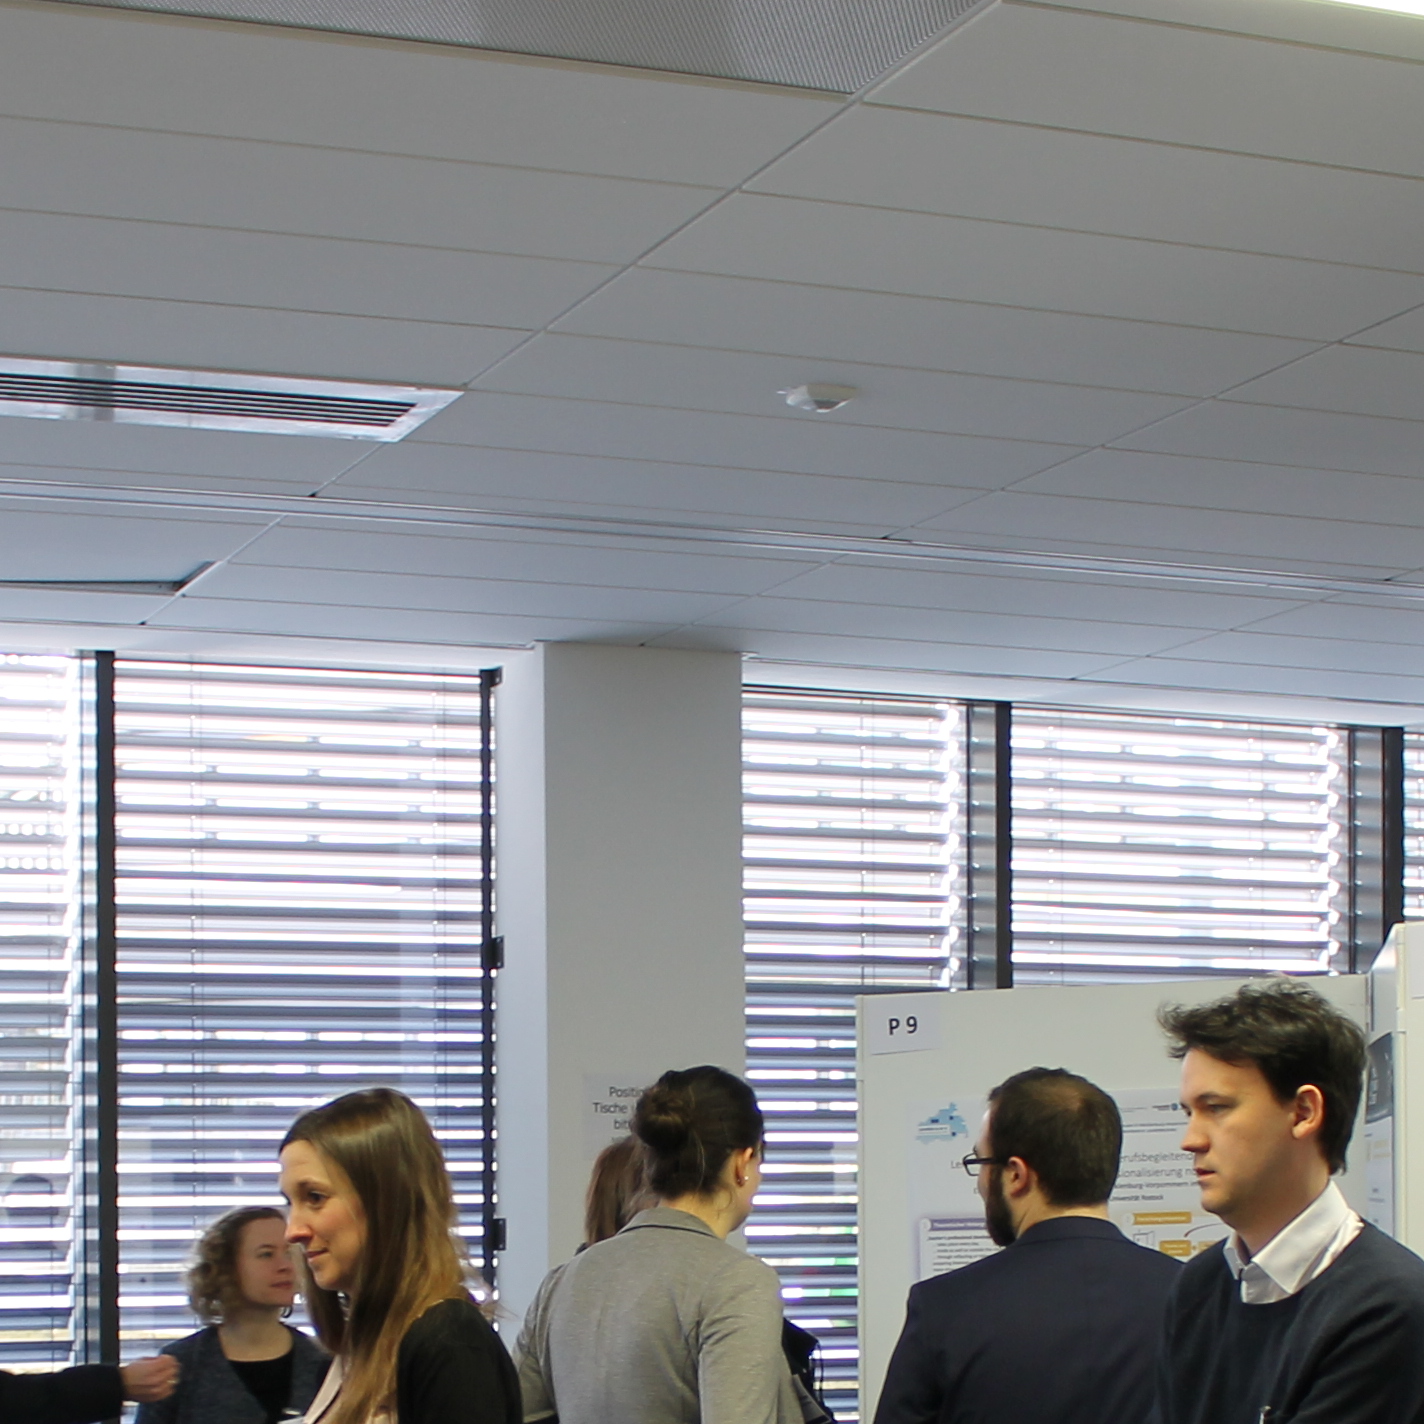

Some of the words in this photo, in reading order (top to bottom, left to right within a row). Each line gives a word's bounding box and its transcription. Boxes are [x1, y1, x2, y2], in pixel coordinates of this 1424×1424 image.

[889, 1018, 900, 1035] P
[906, 1016, 918, 1034] 9
[592, 1102, 628, 1114] Tische
